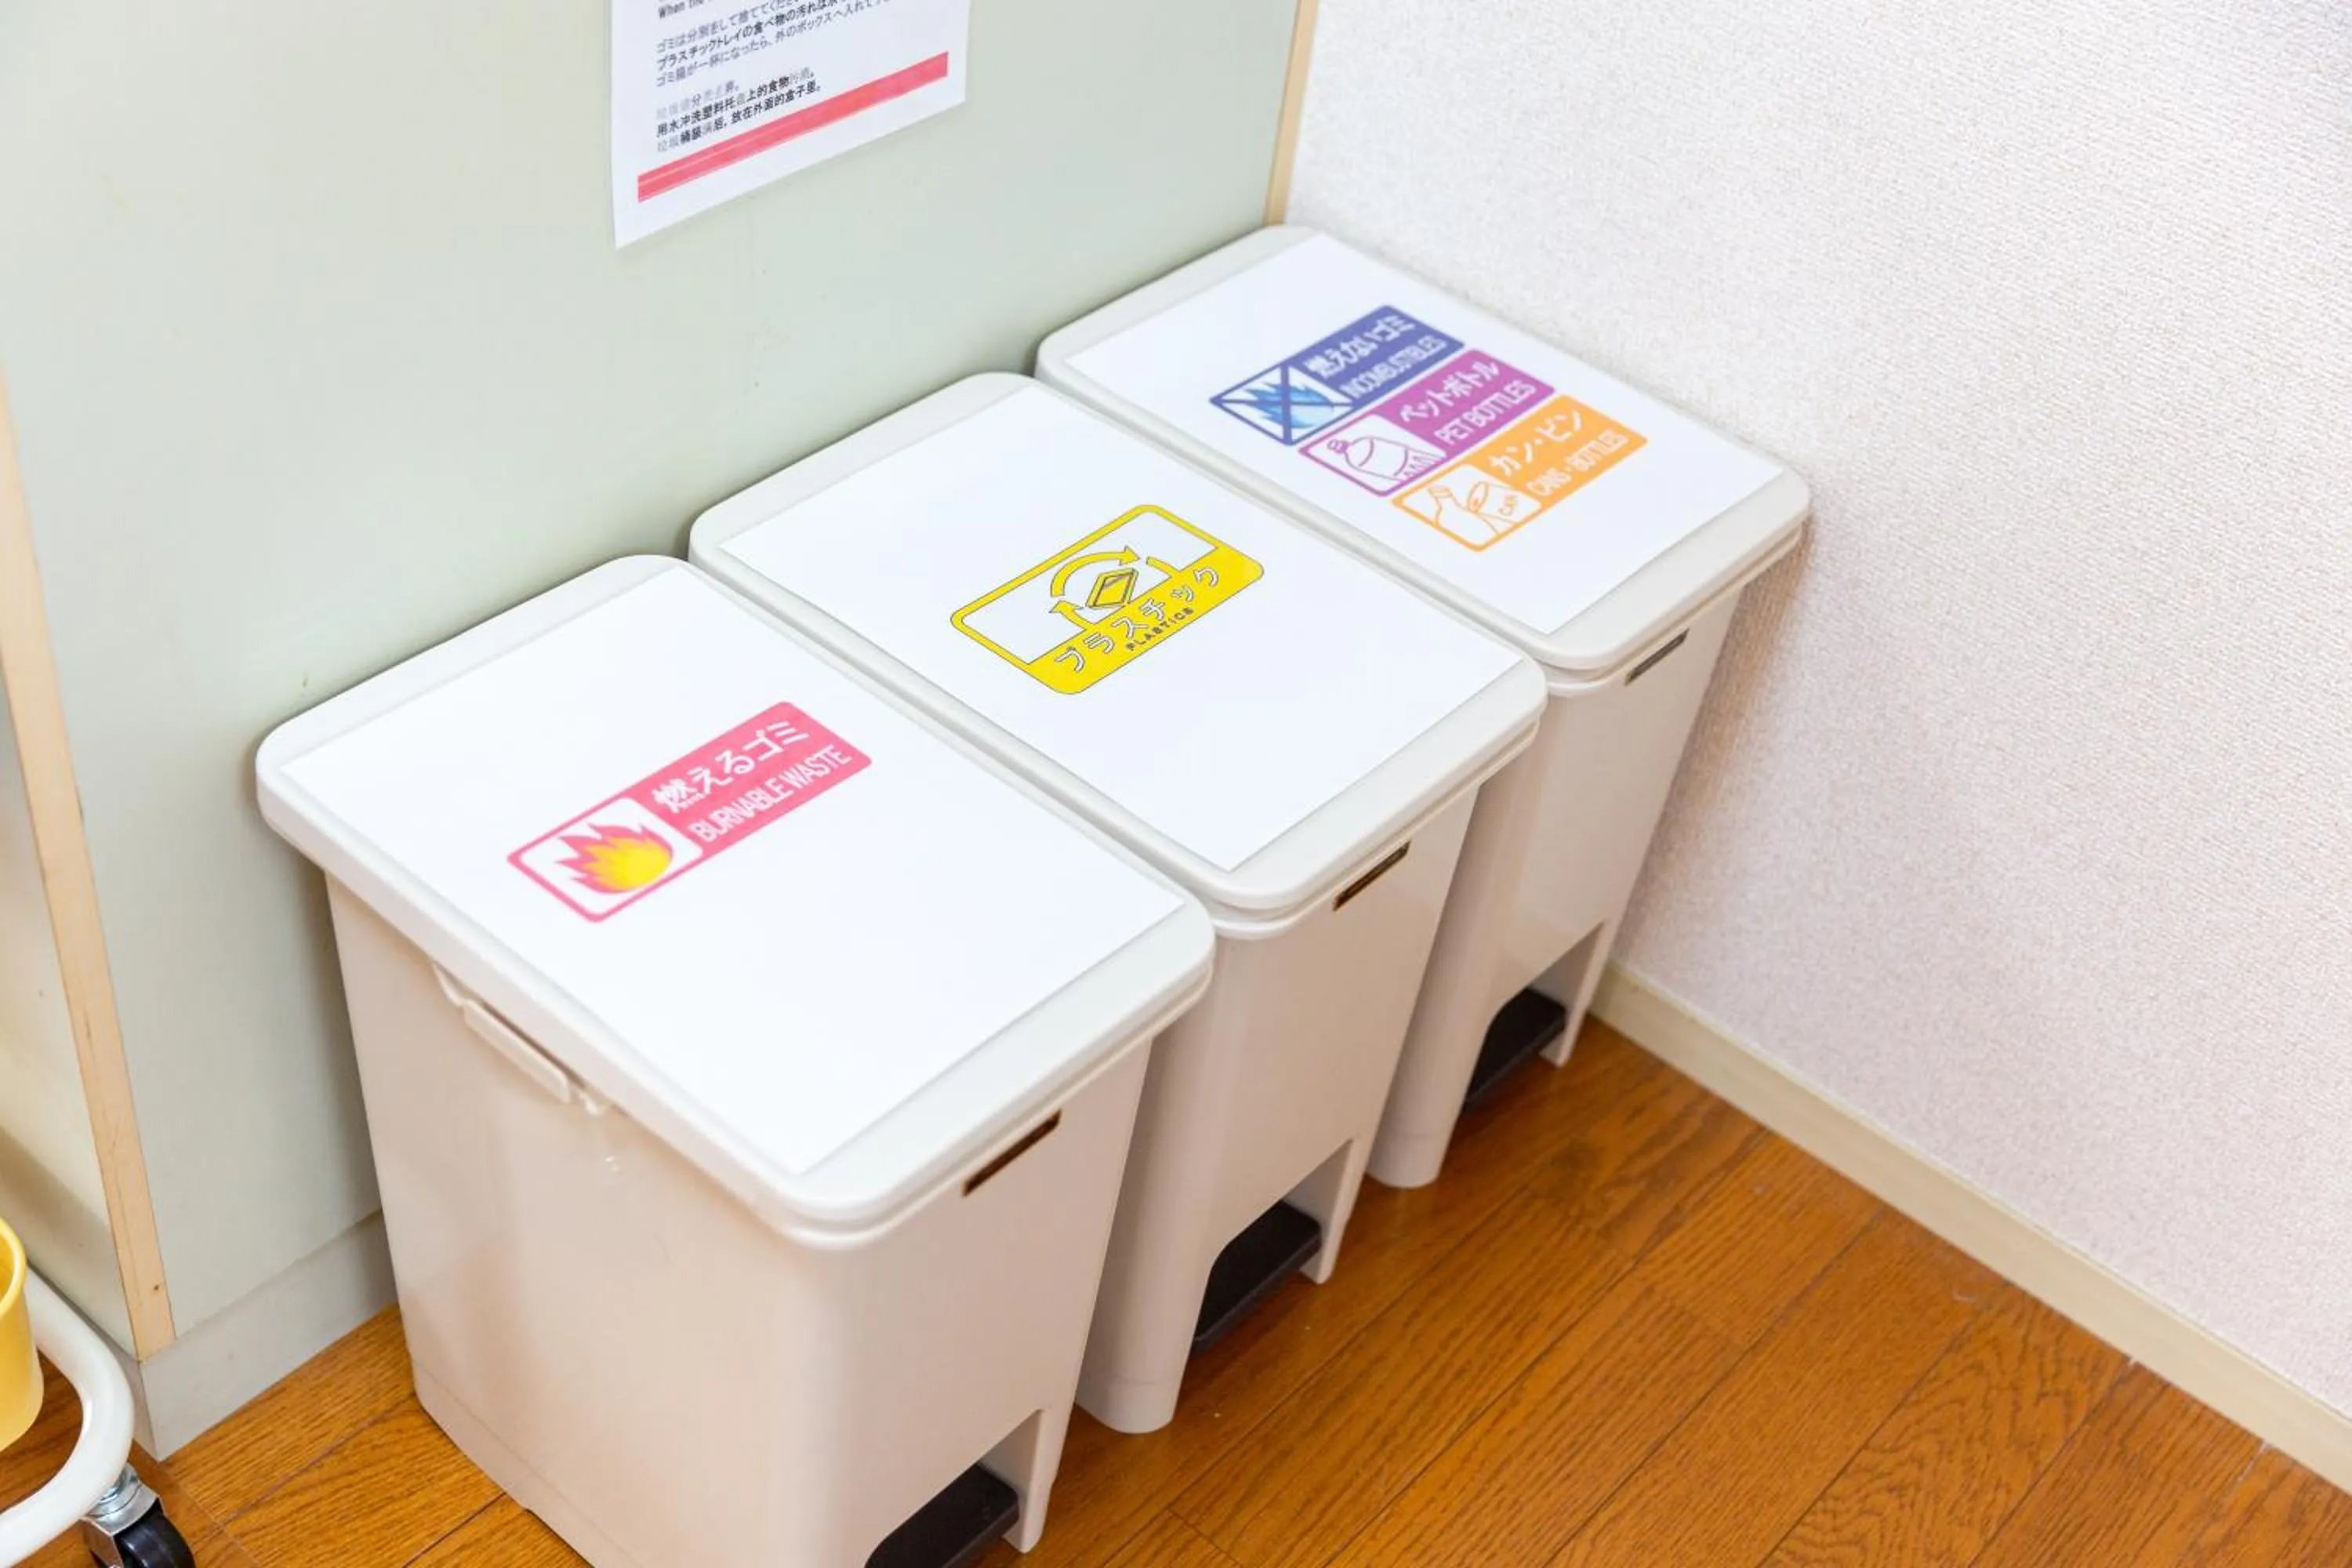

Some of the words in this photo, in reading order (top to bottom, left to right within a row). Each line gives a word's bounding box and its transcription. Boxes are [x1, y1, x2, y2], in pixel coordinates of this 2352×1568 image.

[1303, 315, 1417, 379] 燃えないゴミ
[1399, 361, 1500, 423] ペットボトル
[1433, 417, 1474, 445] PET
[1461, 379, 1537, 427] BOTTLES
[1487, 410, 1582, 477] カン・ビン
[1054, 566, 1219, 672] プラスチック
[1125, 607, 1194, 652] PLASTICS
[652, 720, 810, 814] 燃えるゴミ
[688, 777, 794, 843] BURNABLE
[779, 743, 852, 798] WASTE
